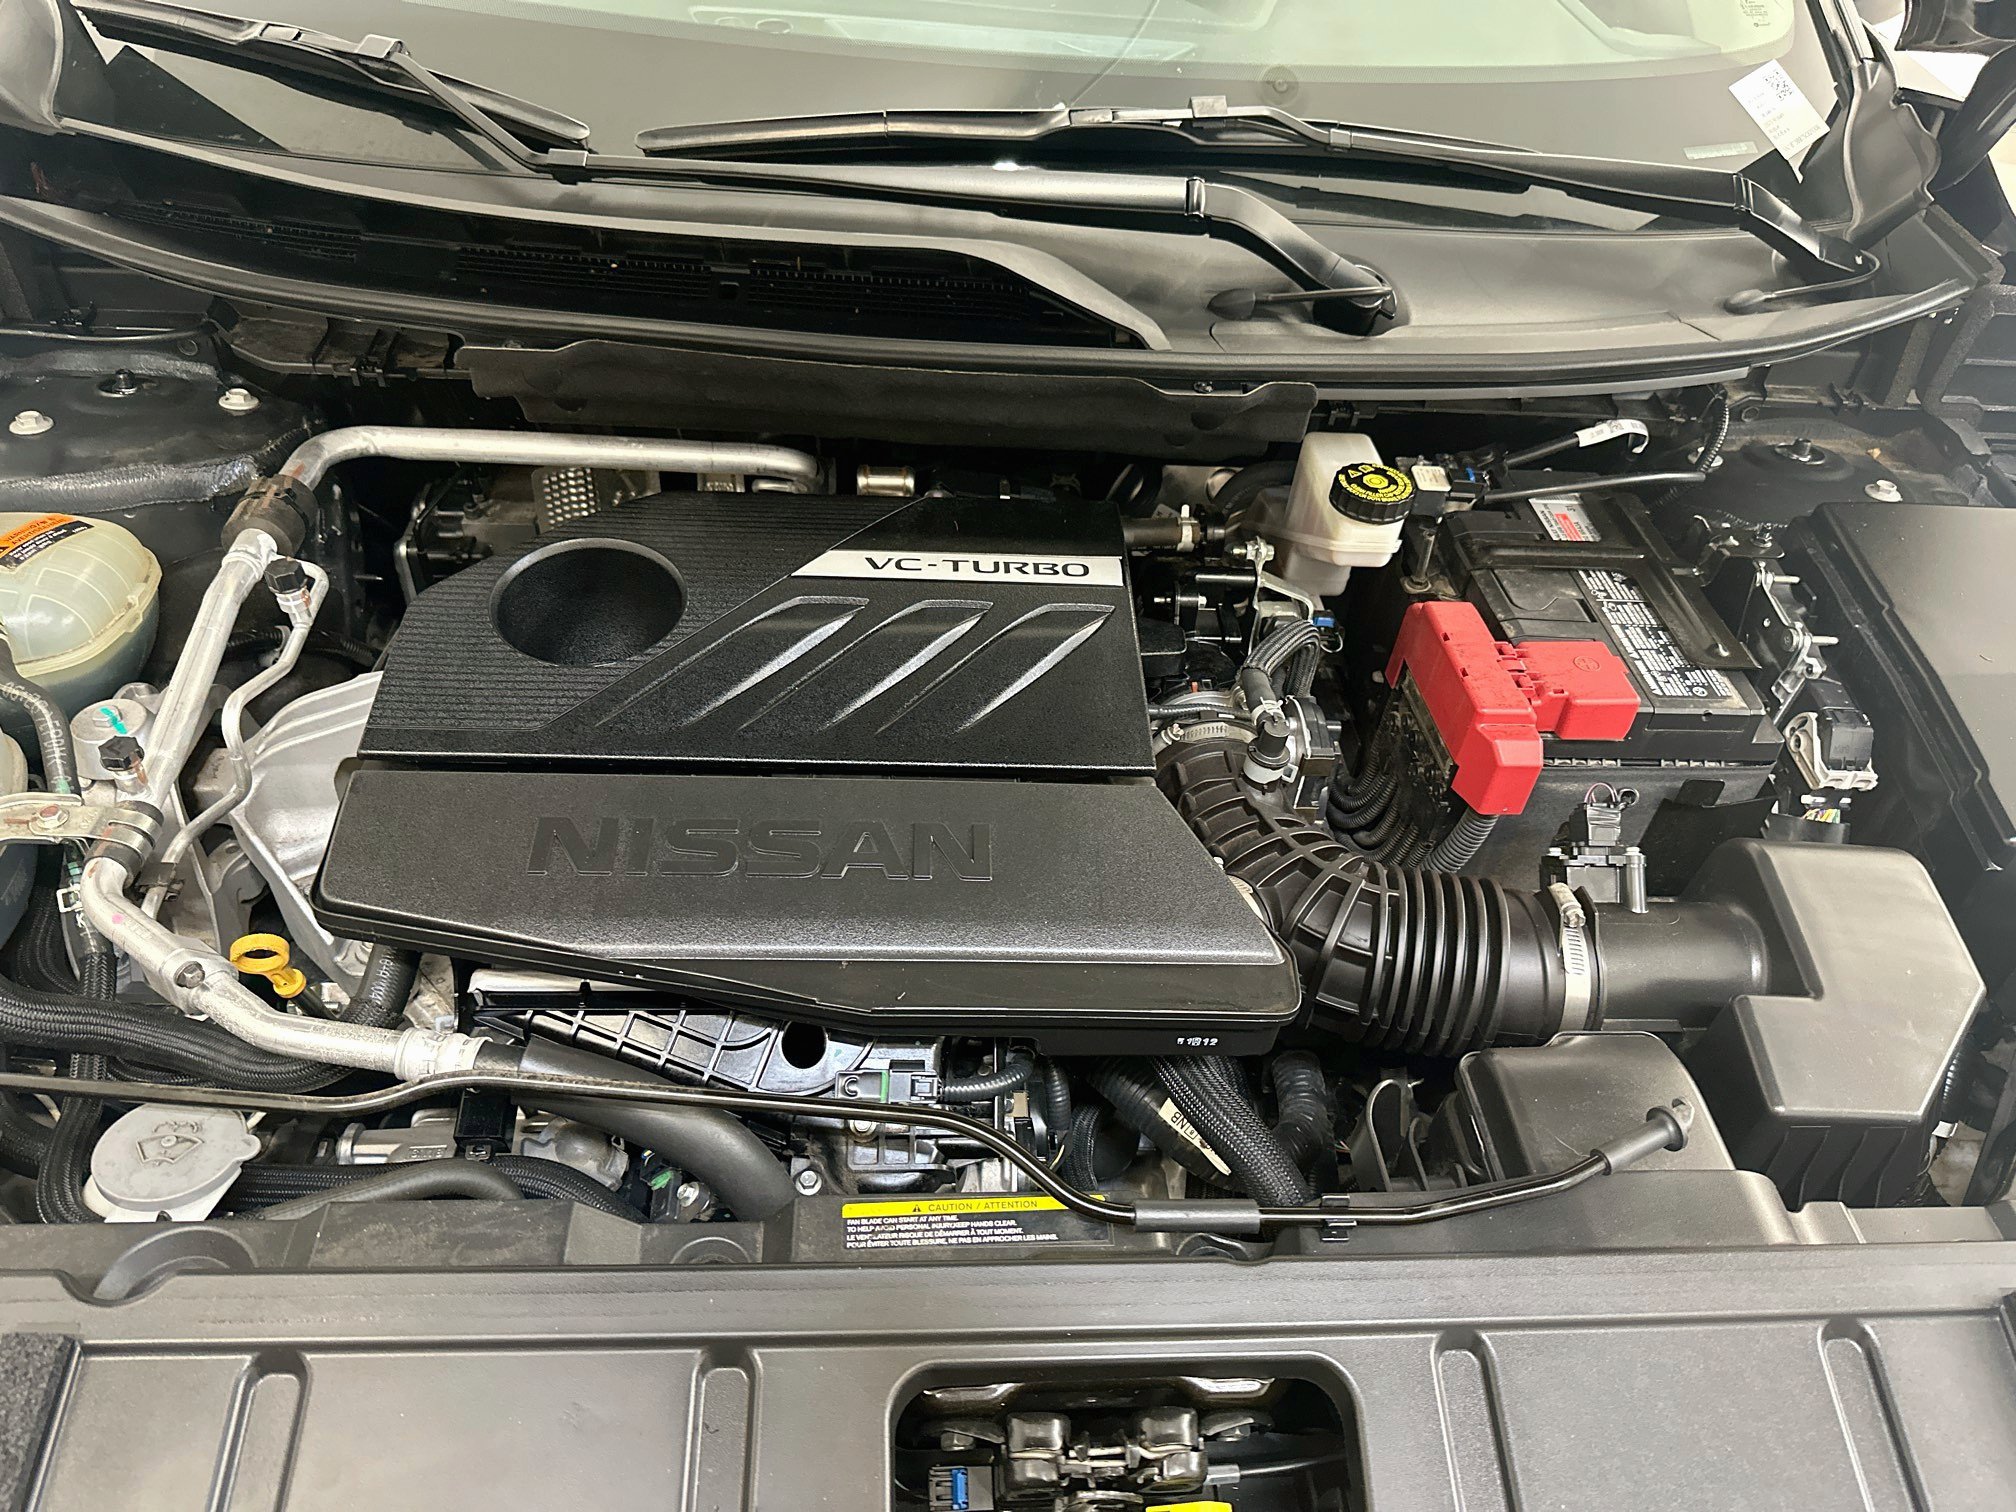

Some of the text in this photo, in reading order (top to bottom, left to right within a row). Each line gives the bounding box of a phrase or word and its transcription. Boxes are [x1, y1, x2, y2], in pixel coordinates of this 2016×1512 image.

[864, 556, 1091, 578] VC-TURBO
[526, 816, 993, 882] NISSAN
[928, 1203, 973, 1213] CAUTION
[984, 1200, 1038, 1211] ATTENTION
[847, 1218, 861, 1226] FAN
[857, 1225, 875, 1233] HELP
[896, 1223, 931, 1231] PERSONAL
[847, 1241, 866, 1249] POUR
[889, 1239, 912, 1247] TOUTE
[983, 1234, 1023, 1242] APPROCHER
